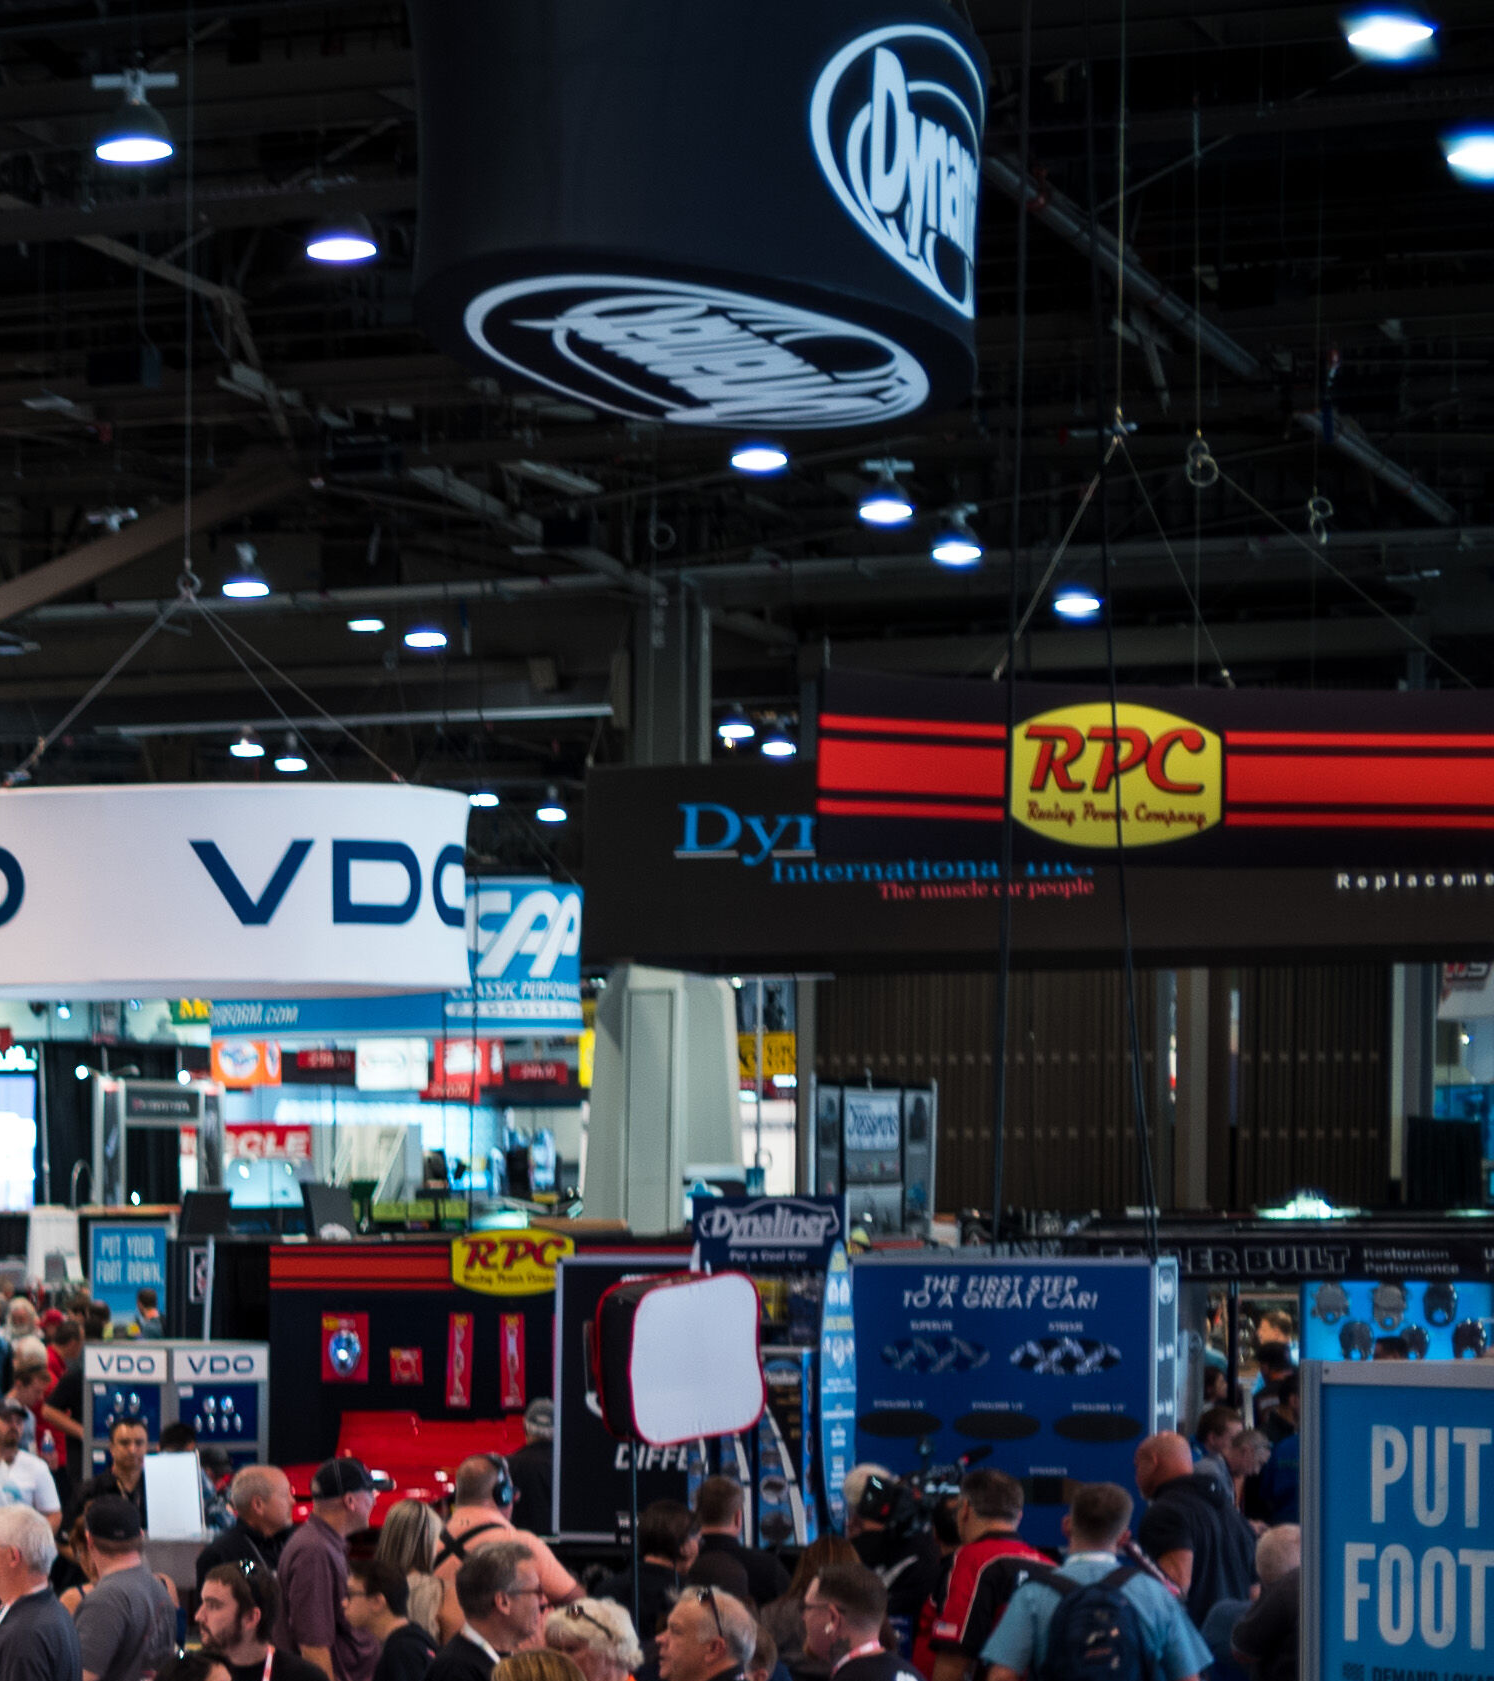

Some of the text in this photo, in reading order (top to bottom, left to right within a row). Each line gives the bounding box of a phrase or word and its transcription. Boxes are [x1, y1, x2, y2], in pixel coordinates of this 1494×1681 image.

[1025, 724, 1206, 795] RPC
[1027, 799, 1076, 828] Racing
[1135, 801, 1207, 831] Company
[878, 876, 1094, 900] The muscle people
[710, 1205, 832, 1245] Dynaliner
[99, 1233, 156, 1259] PUT YOUR
[462, 1238, 561, 1270] RPC
[1363, 1248, 1449, 1260] Restoration
[1243, 1246, 1351, 1274] BUILT
[1363, 1262, 1460, 1275] Performance
[923, 1275, 1078, 1293] THE FIRST STEP
[902, 1292, 927, 1309] TO
[930, 1292, 955, 1309] A
[963, 1292, 1034, 1310] GREAT
[97, 1355, 157, 1374] VDO
[187, 1355, 256, 1375] VDO
[1370, 1424, 1492, 1529] PUT
[1343, 1541, 1494, 1651] FOOT
